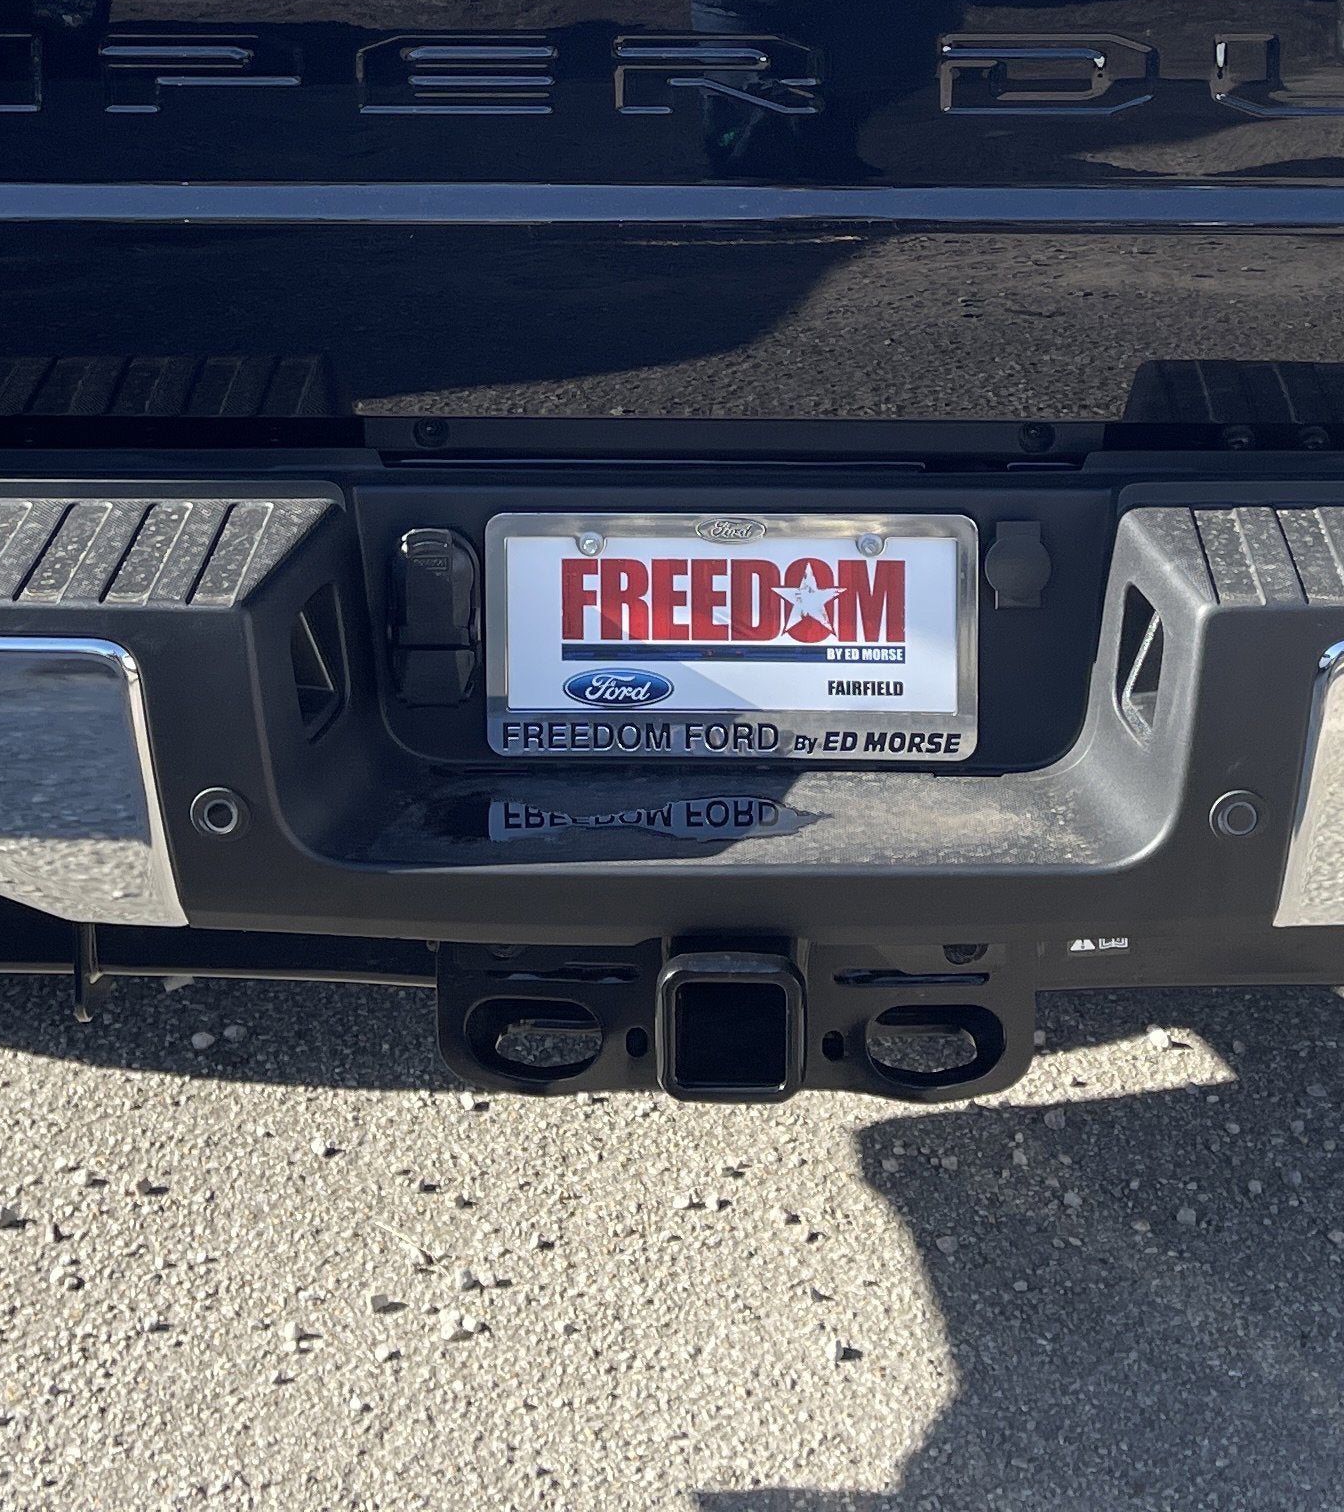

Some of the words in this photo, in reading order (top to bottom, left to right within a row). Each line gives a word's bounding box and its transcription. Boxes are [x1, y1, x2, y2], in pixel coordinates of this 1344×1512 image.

[709, 519, 753, 539] Ford
[561, 557, 906, 644] FREEDOM
[826, 648, 843, 661] BY
[844, 648, 860, 661] ED
[861, 648, 904, 662] MORSE
[584, 673, 652, 701] Ford
[827, 679, 905, 697] FAIRFIELD
[501, 721, 673, 752] FREEDOM
[684, 721, 780, 753] FORD
[793, 734, 819, 755] By
[822, 731, 857, 753] ED
[862, 731, 963, 755] MORSE
